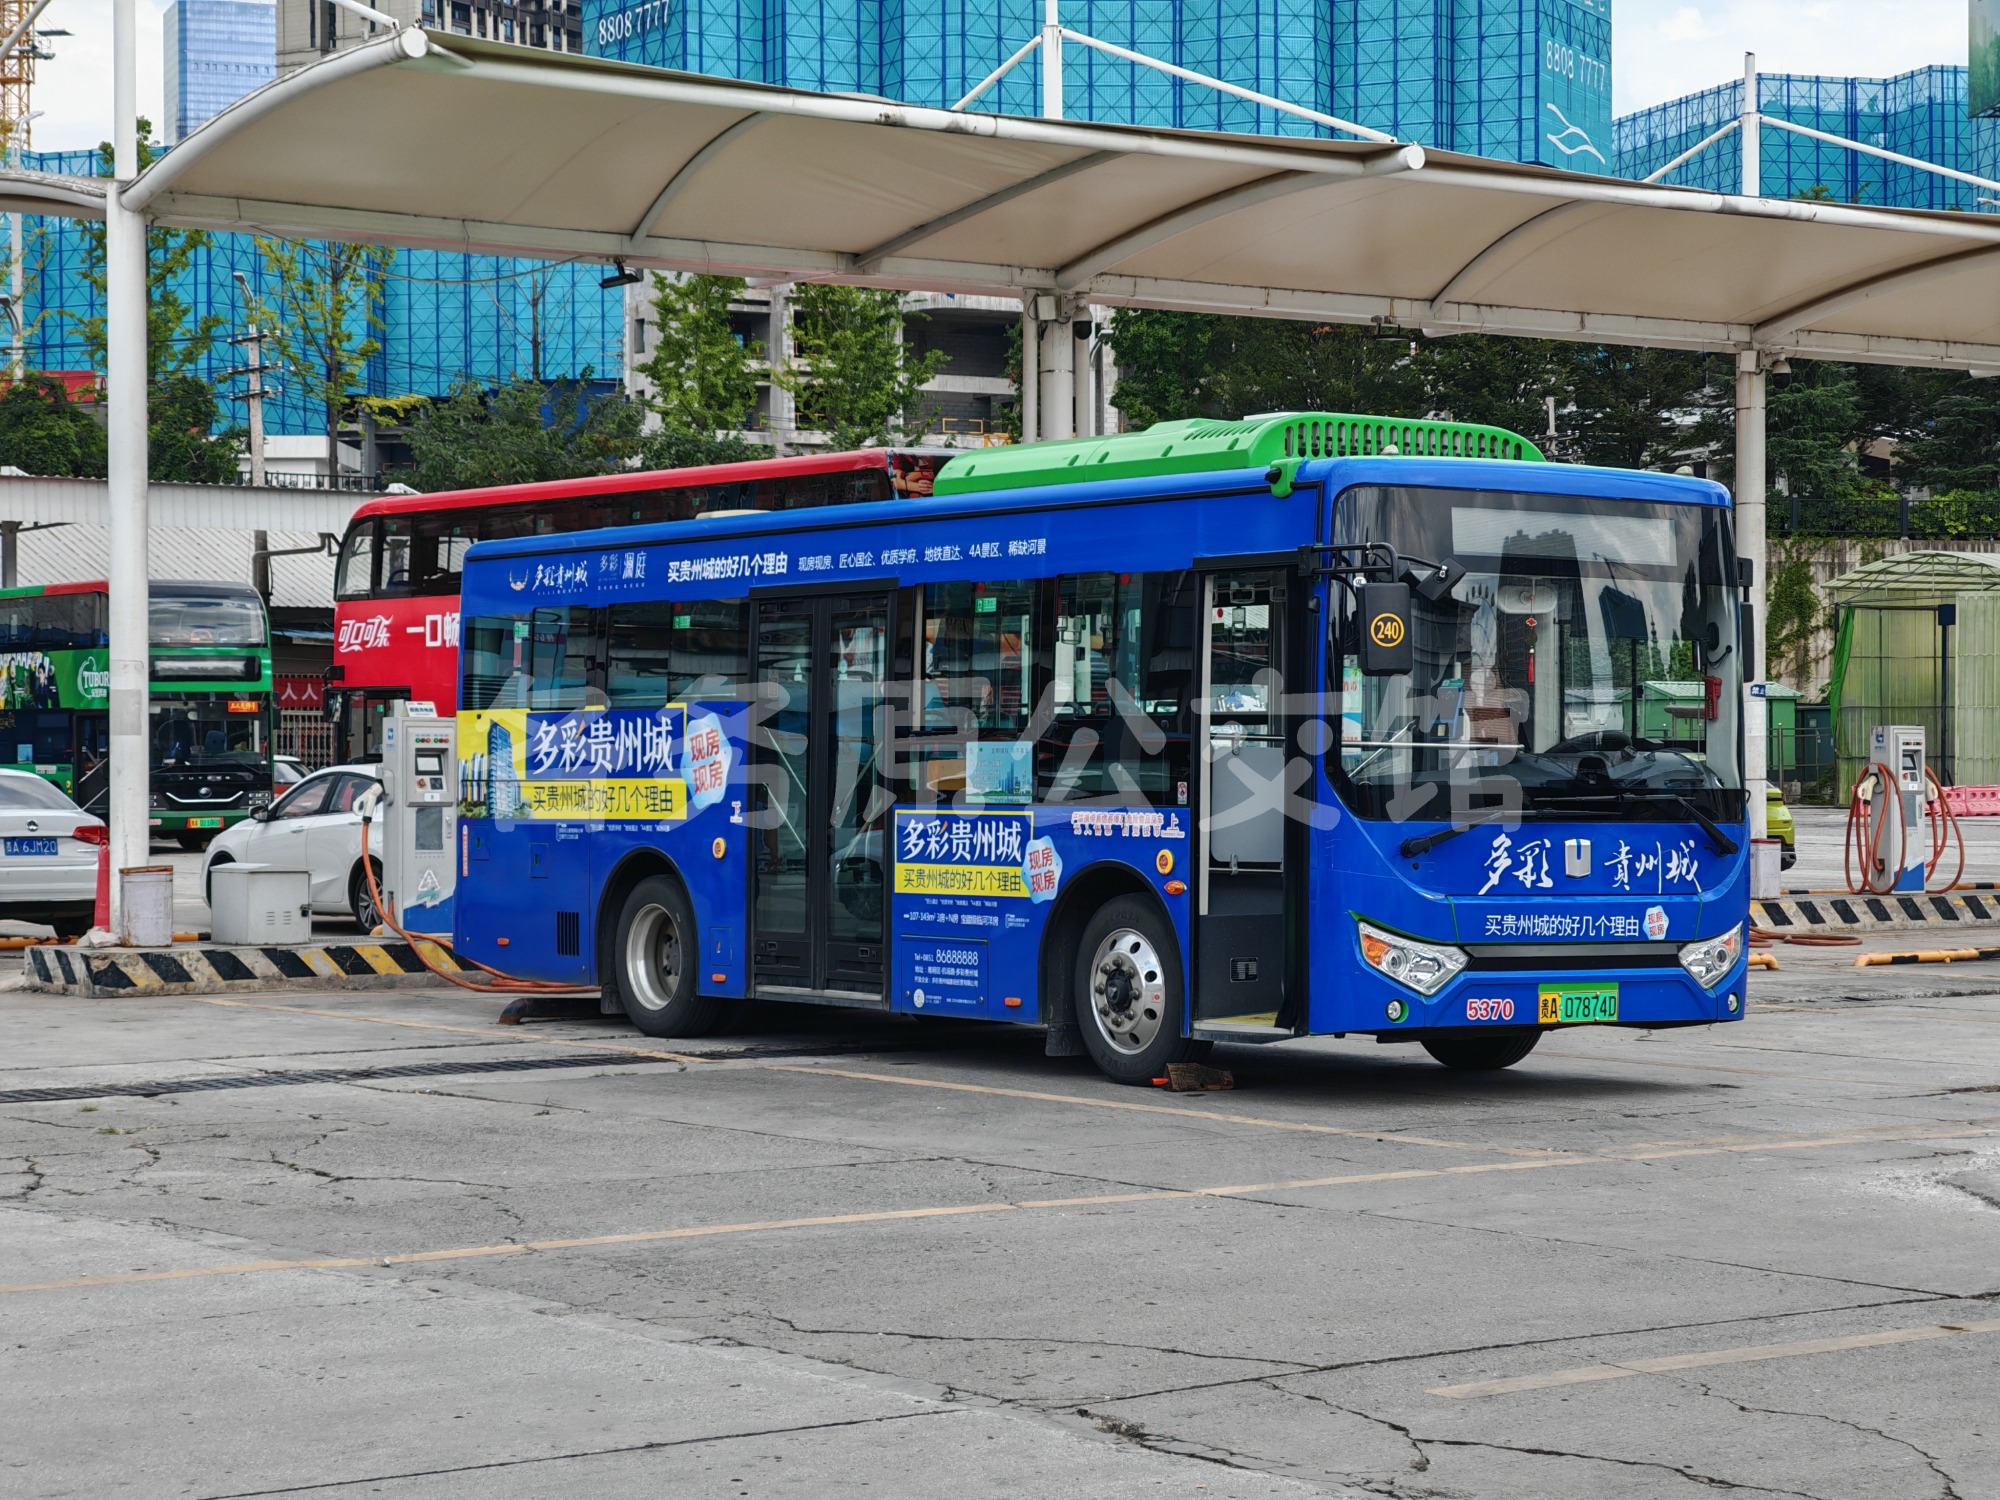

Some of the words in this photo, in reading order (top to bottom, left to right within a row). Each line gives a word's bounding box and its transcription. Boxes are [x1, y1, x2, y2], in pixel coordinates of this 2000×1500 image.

[599, 10, 632, 45] 8808
[635, 0, 669, 33] 7777
[1546, 40, 1574, 79] 8808
[1580, 54, 1605, 92] 7777
[667, 551, 788, 583] 买贵州城的好几个理由
[338, 614, 393, 653] 可口可乐
[1377, 621, 1399, 639] 240
[83, 671, 110, 688] TUBOR
[532, 716, 674, 775] 多彩贵州城
[690, 728, 720, 762] 现房
[693, 759, 723, 793] 现房
[533, 785, 673, 814] 买贵州城的好几个理由
[1167, 814, 1179, 831] 上
[22, 840, 57, 853] 6JM20
[902, 818, 1022, 863] 多彩贵州城
[1028, 847, 1053, 871] 现房
[903, 868, 1022, 893] 买贵州城的好几个理由
[1031, 870, 1056, 894] 现房
[1485, 913, 1639, 937] 买贵州城的好几个理由
[936, 948, 979, 966] 86888888
[1466, 1000, 1514, 1021] 5370
[1540, 998, 1558, 1019] 贵A
[1565, 995, 1617, 1019] 07874D
